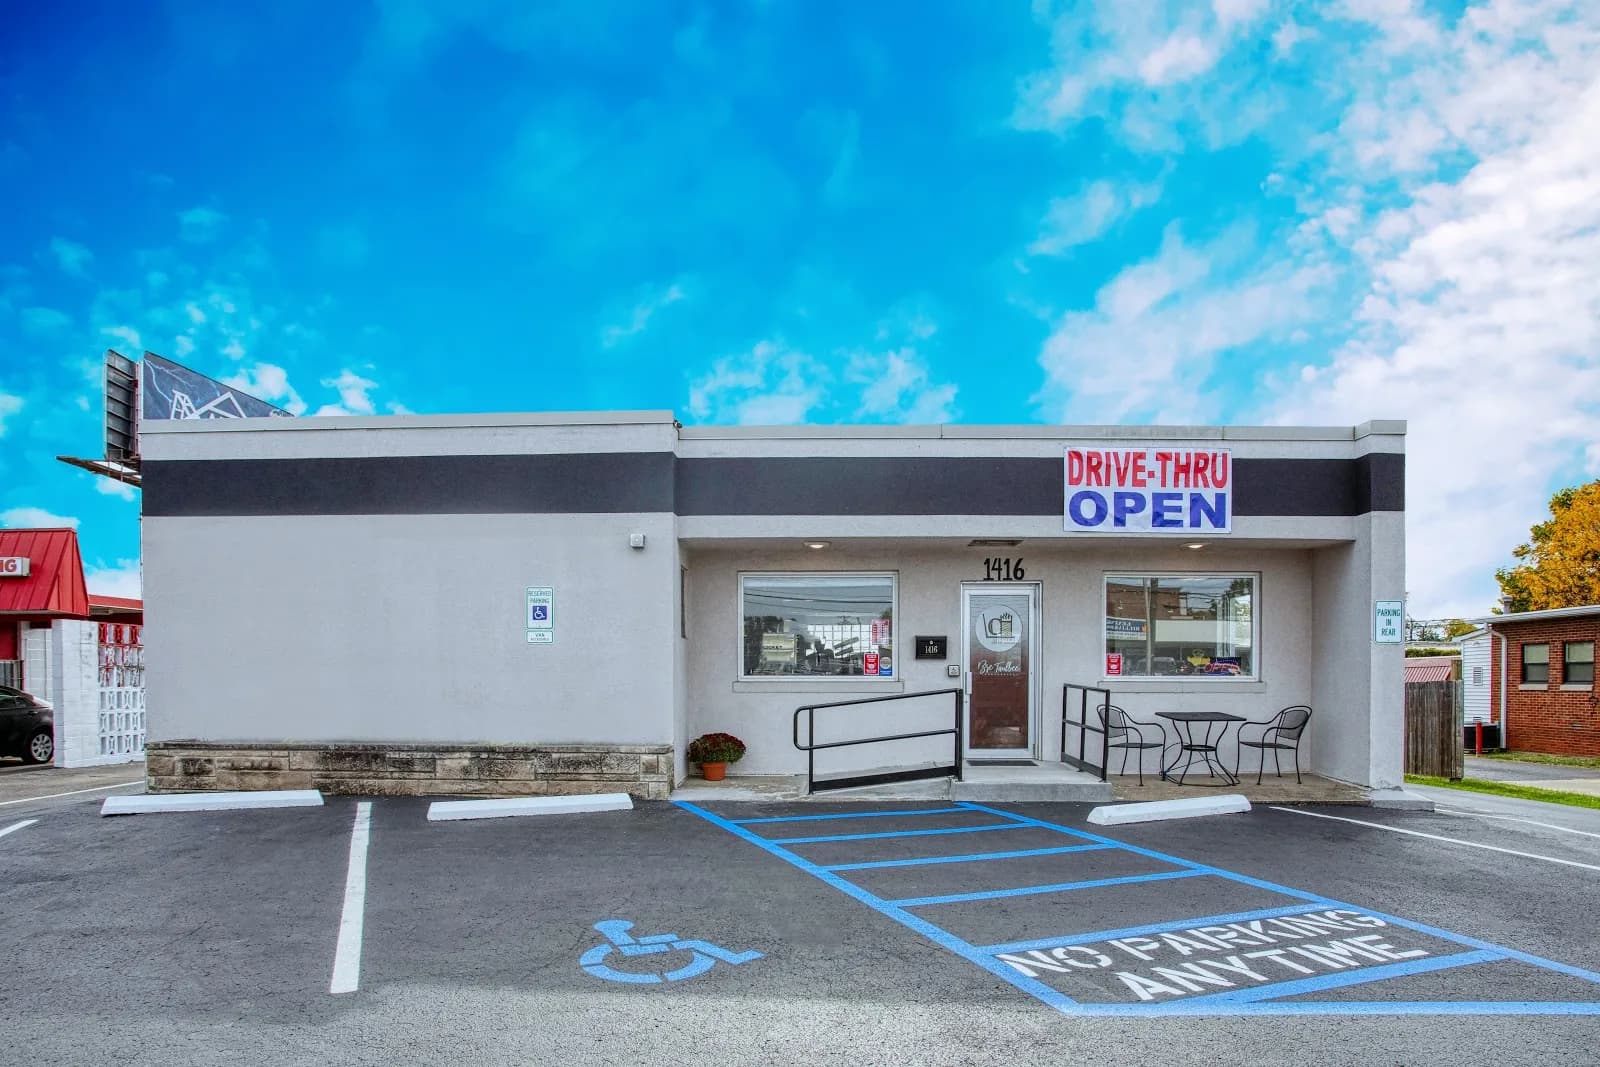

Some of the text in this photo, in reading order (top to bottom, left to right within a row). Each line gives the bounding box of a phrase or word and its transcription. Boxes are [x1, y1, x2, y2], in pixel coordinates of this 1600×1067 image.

[1067, 450, 1228, 488] DRIVE-THRU
[1068, 490, 1227, 529] OPEN
[983, 557, 1025, 581] 1416
[1376, 608, 1400, 616] PARKING
[1381, 628, 1396, 636] REAR
[924, 645, 938, 654] 1416
[996, 909, 1387, 978] NO PARKING
[1115, 934, 1430, 1001] ANYTIME
